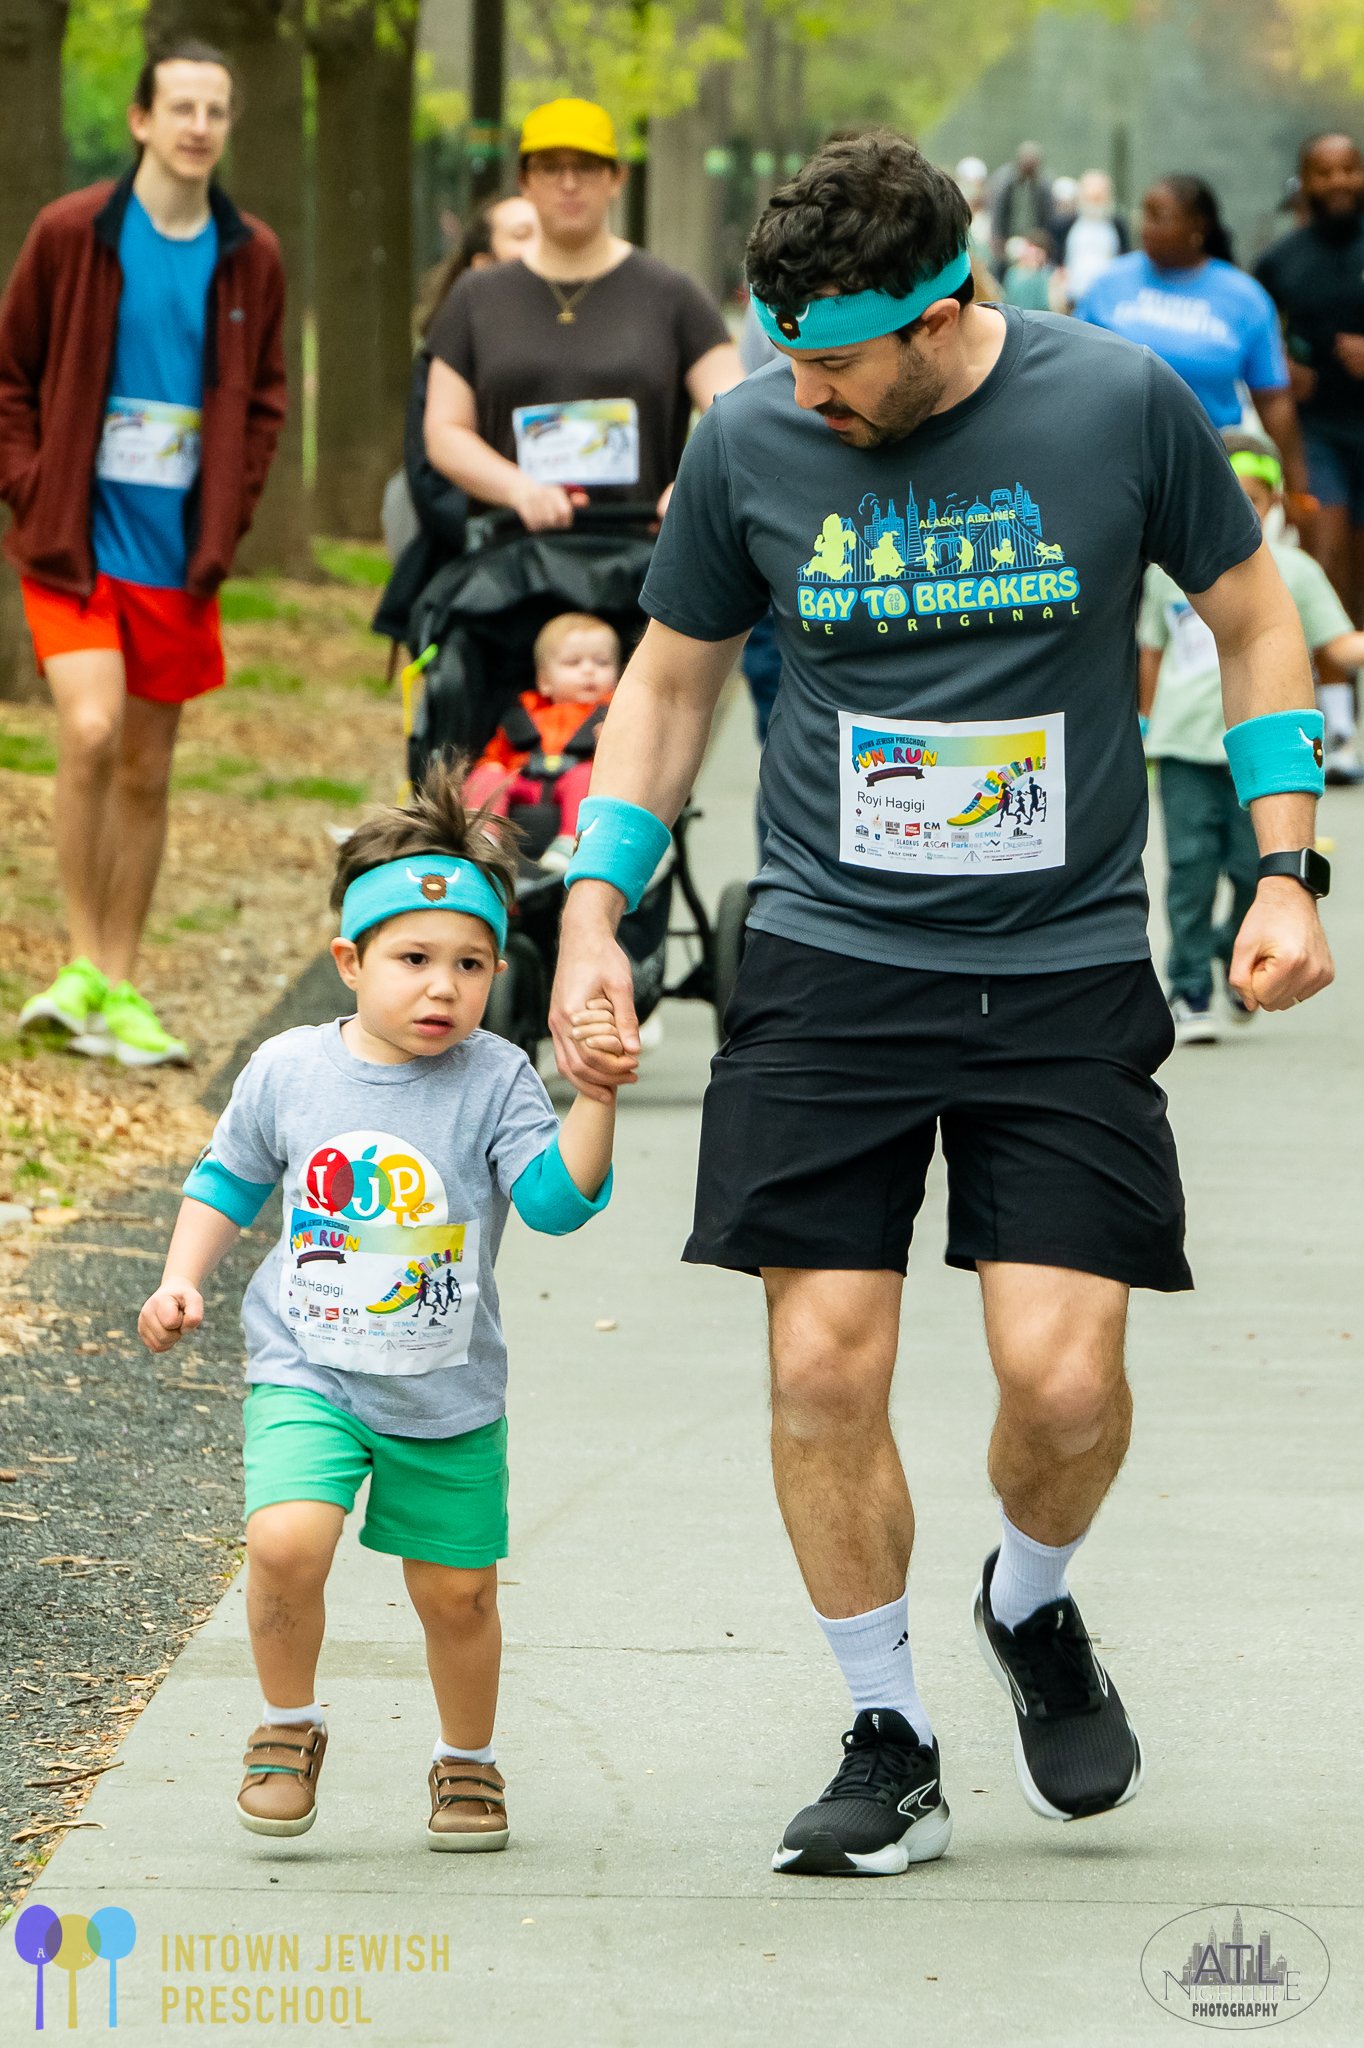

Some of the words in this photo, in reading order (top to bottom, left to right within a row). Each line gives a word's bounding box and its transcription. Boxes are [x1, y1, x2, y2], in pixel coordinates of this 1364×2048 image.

[919, 515, 963, 529] ALASKA
[966, 509, 1016, 524] AIRLINES
[799, 588, 856, 618] BAY
[862, 587, 907, 616] TO
[915, 569, 1079, 613] BREAKERS
[888, 593, 901, 602] 20
[889, 602, 900, 611] 18
[802, 620, 834, 635] BE
[877, 602, 1080, 634] ORIGINAL
[852, 747, 886, 774] FUN
[893, 746, 939, 767] RUN
[857, 791, 882, 807] Royi
[885, 796, 925, 813] Hagigi
[319, 1229, 361, 1252] RUN
[308, 1279, 344, 1298] Hagigi
